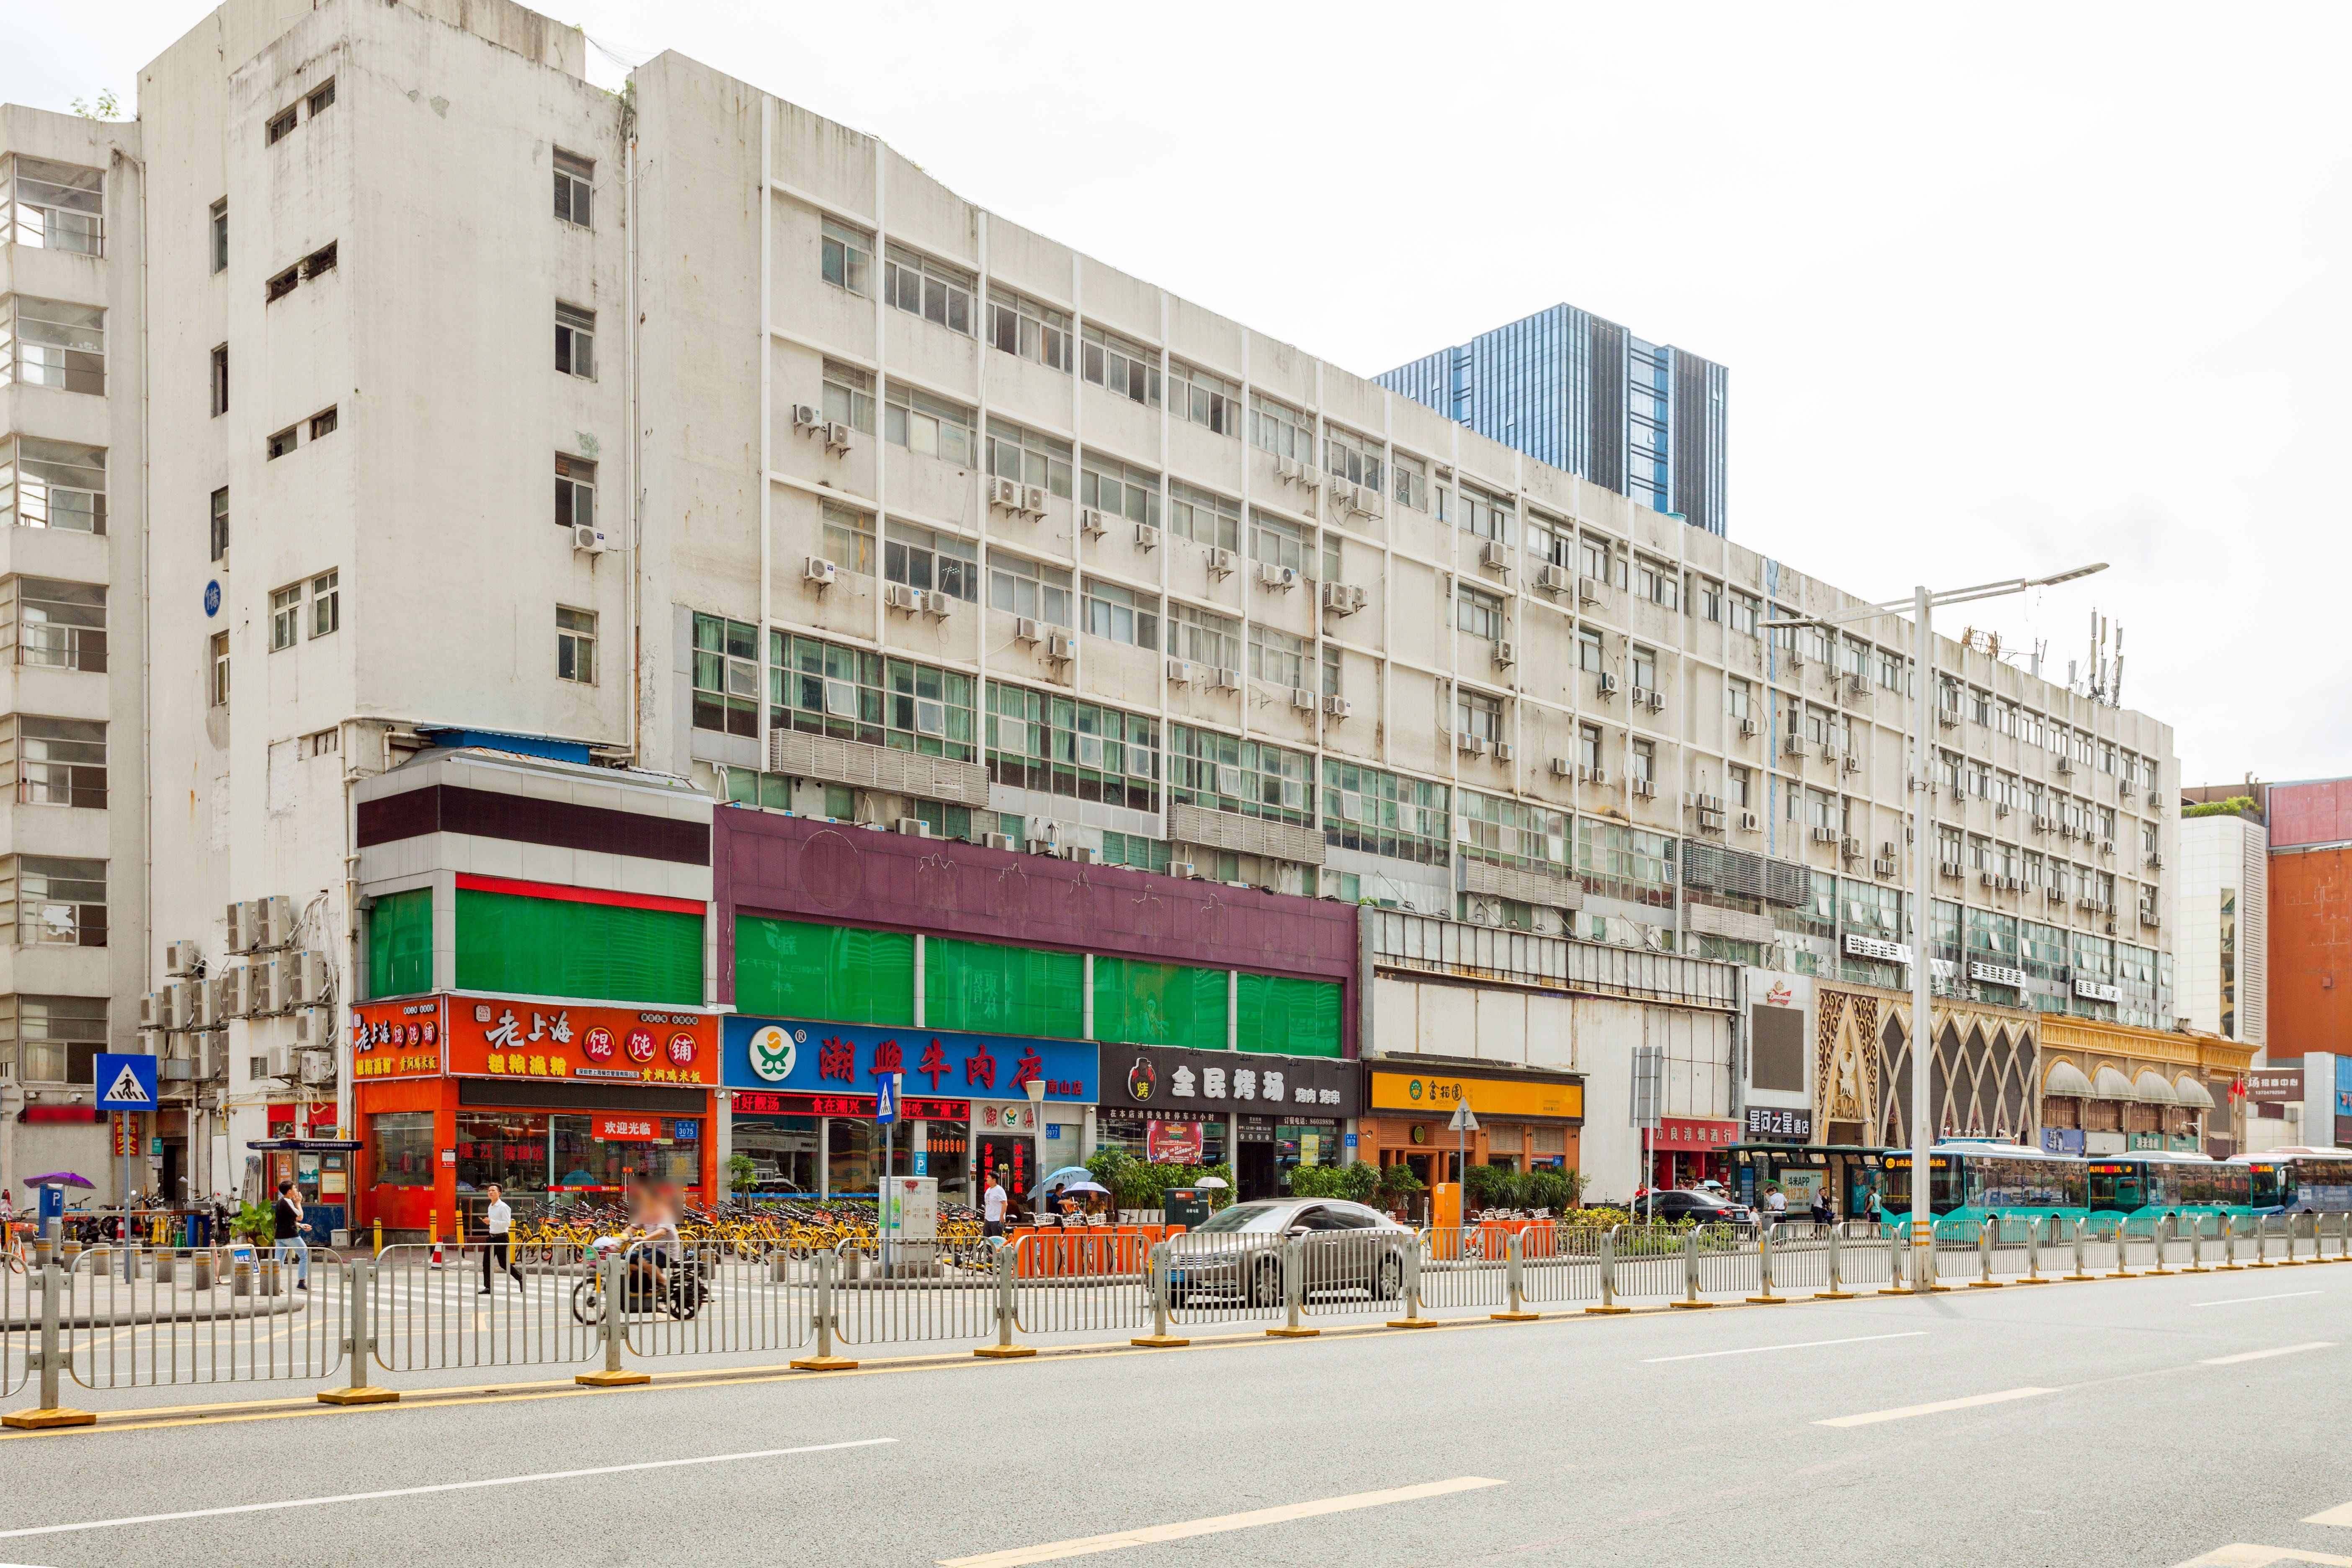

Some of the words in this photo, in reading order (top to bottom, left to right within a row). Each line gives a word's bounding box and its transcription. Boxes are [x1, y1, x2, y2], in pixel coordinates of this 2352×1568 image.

[355, 1020, 389, 1053] 老上海
[395, 1026, 432, 1042] 馄饨铺
[486, 1009, 574, 1049] 老上海
[591, 1031, 693, 1062] 馄饨铺
[641, 1068, 701, 1083] 黄焖鸡米饭
[1172, 1065, 1284, 1101] 全民烤场
[1047, 1079, 1083, 1096] 南山店
[1137, 1082, 1148, 1098] 烤
[812, 1098, 859, 1114] 食在潮兴
[1110, 1109, 1214, 1121] 在本店消费免费停车3小时
[605, 1122, 650, 1135] 欢迎光临
[918, 1161, 924, 1170] P
[985, 1143, 993, 1192] 多谢
[1014, 1144, 1023, 1193] 欢迎光临
[53, 1192, 60, 1206] P
